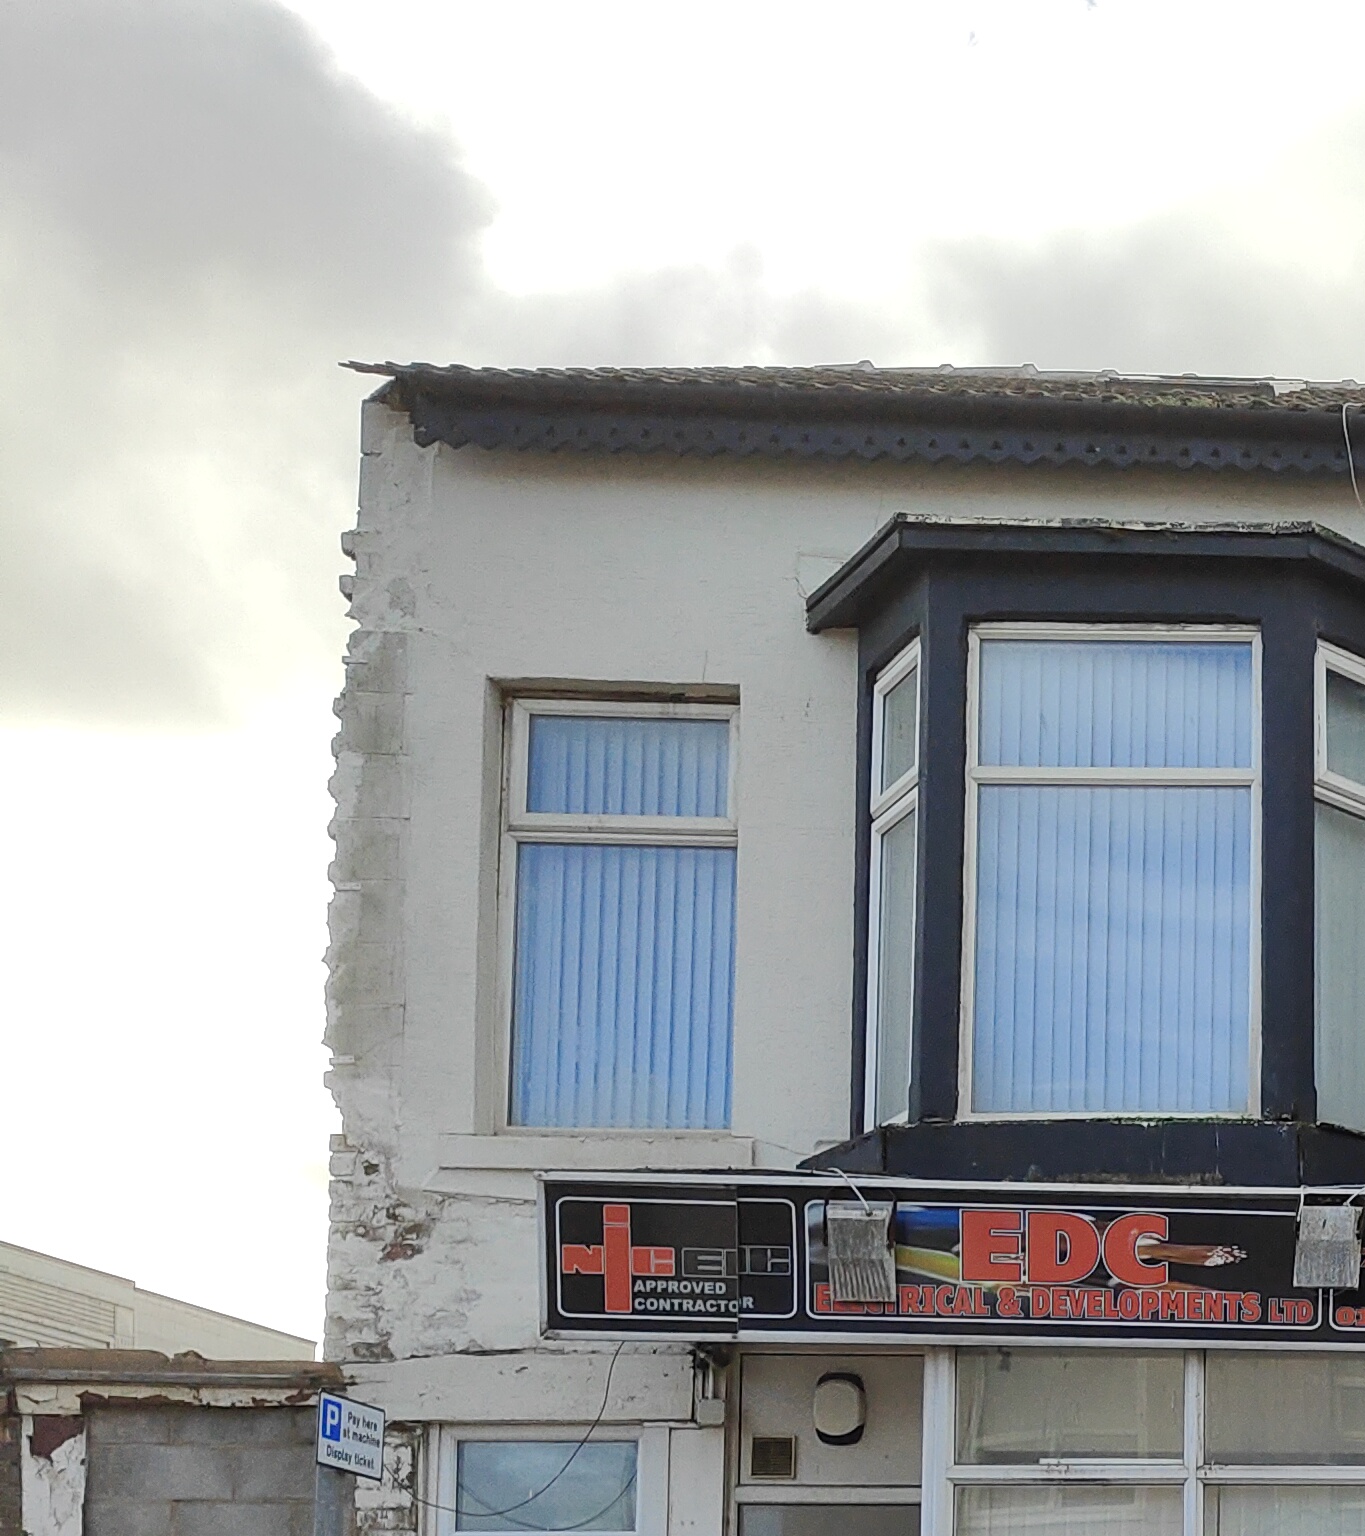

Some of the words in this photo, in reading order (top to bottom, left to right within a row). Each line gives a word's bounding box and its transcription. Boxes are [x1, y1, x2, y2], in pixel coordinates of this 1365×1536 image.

[959, 1208, 1169, 1288] EDC
[633, 1279, 727, 1295] APPROVED
[633, 1296, 755, 1313] CONTRACTOR
[814, 1282, 990, 1317] ERICAL
[996, 1285, 1025, 1317] &
[1030, 1286, 1261, 1323] DEVELOPMENTS
[1268, 1298, 1314, 1324] LTD
[326, 1403, 339, 1436] P
[347, 1411, 360, 1428] Pay
[362, 1415, 378, 1432] here
[343, 1427, 350, 1439] at
[352, 1430, 380, 1448] machine
[326, 1444, 352, 1465] Display
[354, 1452, 375, 1470] ticket
